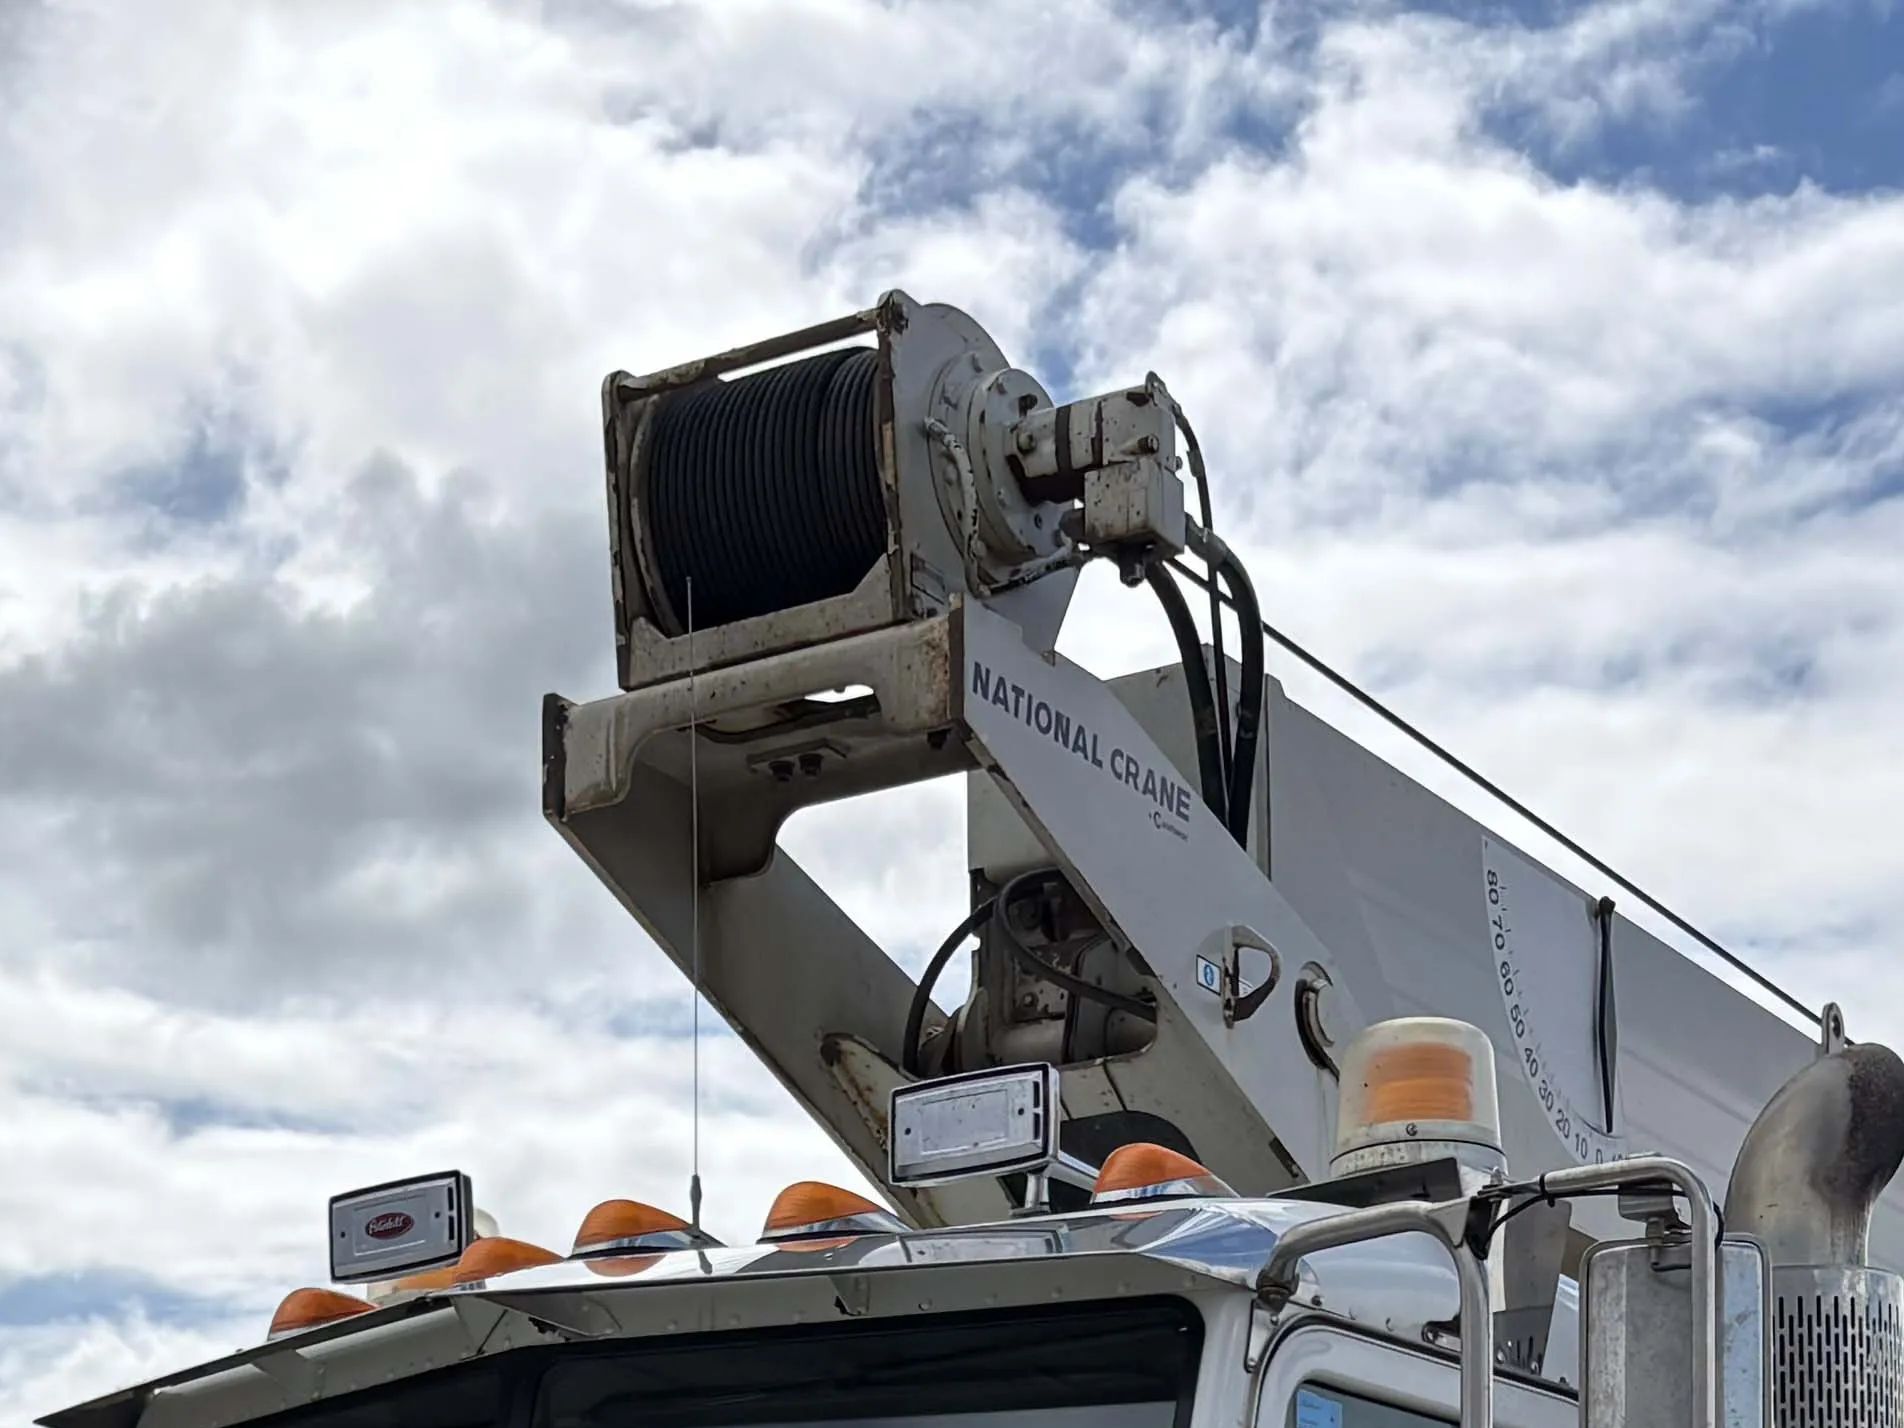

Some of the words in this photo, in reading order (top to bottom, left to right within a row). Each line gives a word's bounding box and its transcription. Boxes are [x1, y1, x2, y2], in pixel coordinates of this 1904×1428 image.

[972, 661, 1103, 769] NATIONAL
[1110, 748, 1192, 823] CRANE
[1486, 868, 1500, 906] 80
[1492, 915, 1505, 950] 70
[1500, 961, 1514, 996] 60
[1510, 1004, 1525, 1038] 50
[1523, 1046, 1538, 1078] 40
[1538, 1079, 1554, 1111] 30
[1555, 1108, 1570, 1139] 20
[1575, 1133, 1588, 1160] 10
